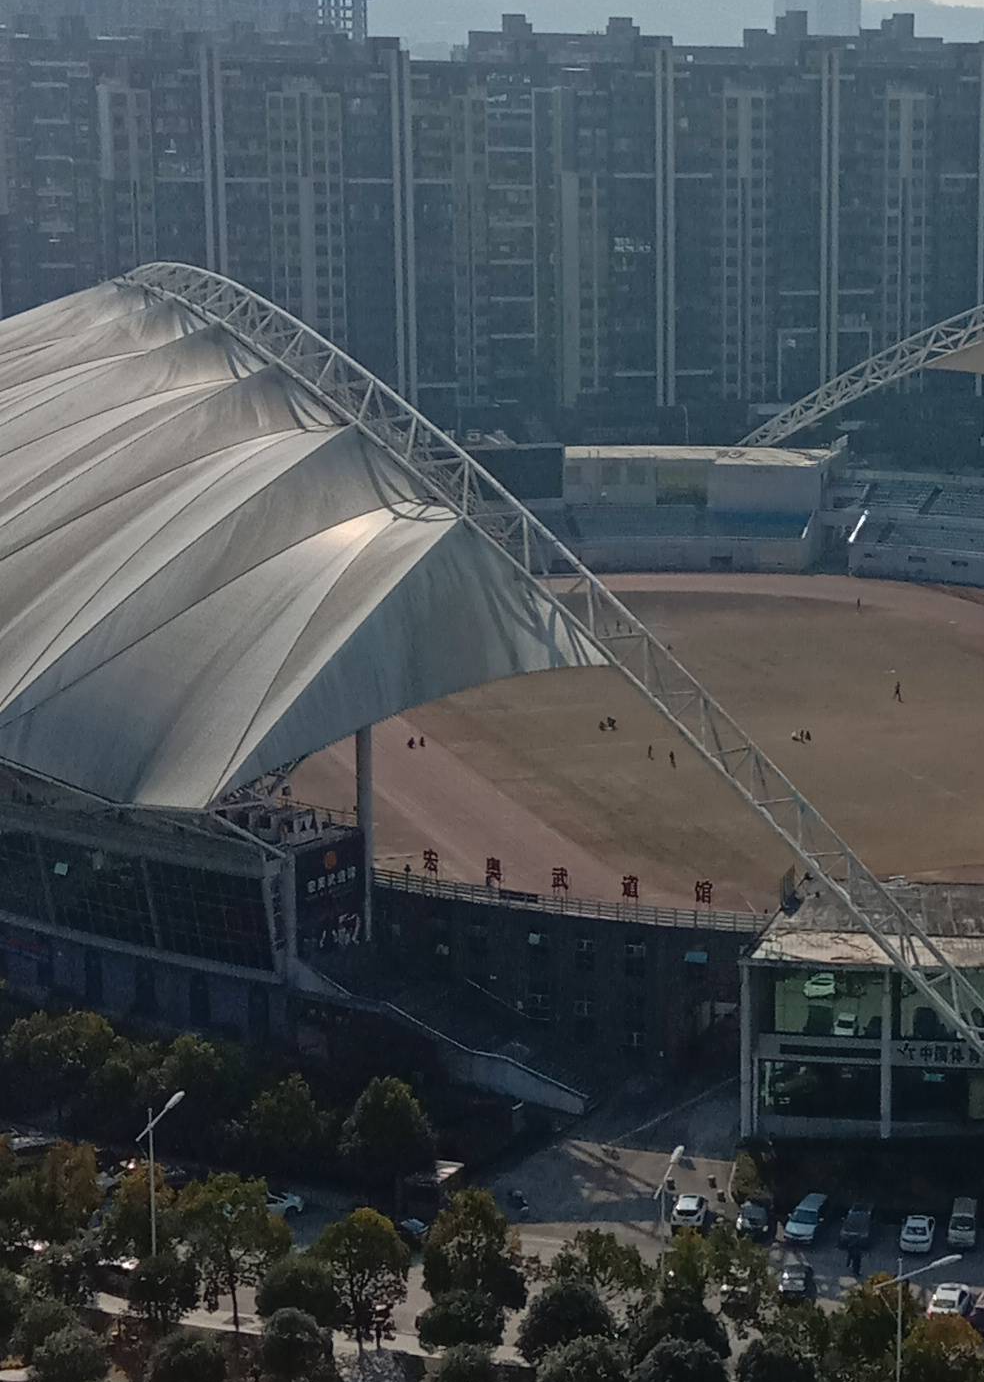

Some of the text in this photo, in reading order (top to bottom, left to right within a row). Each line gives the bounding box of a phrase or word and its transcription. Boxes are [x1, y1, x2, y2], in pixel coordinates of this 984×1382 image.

[423, 849, 713, 905] 宏奥武道馆
